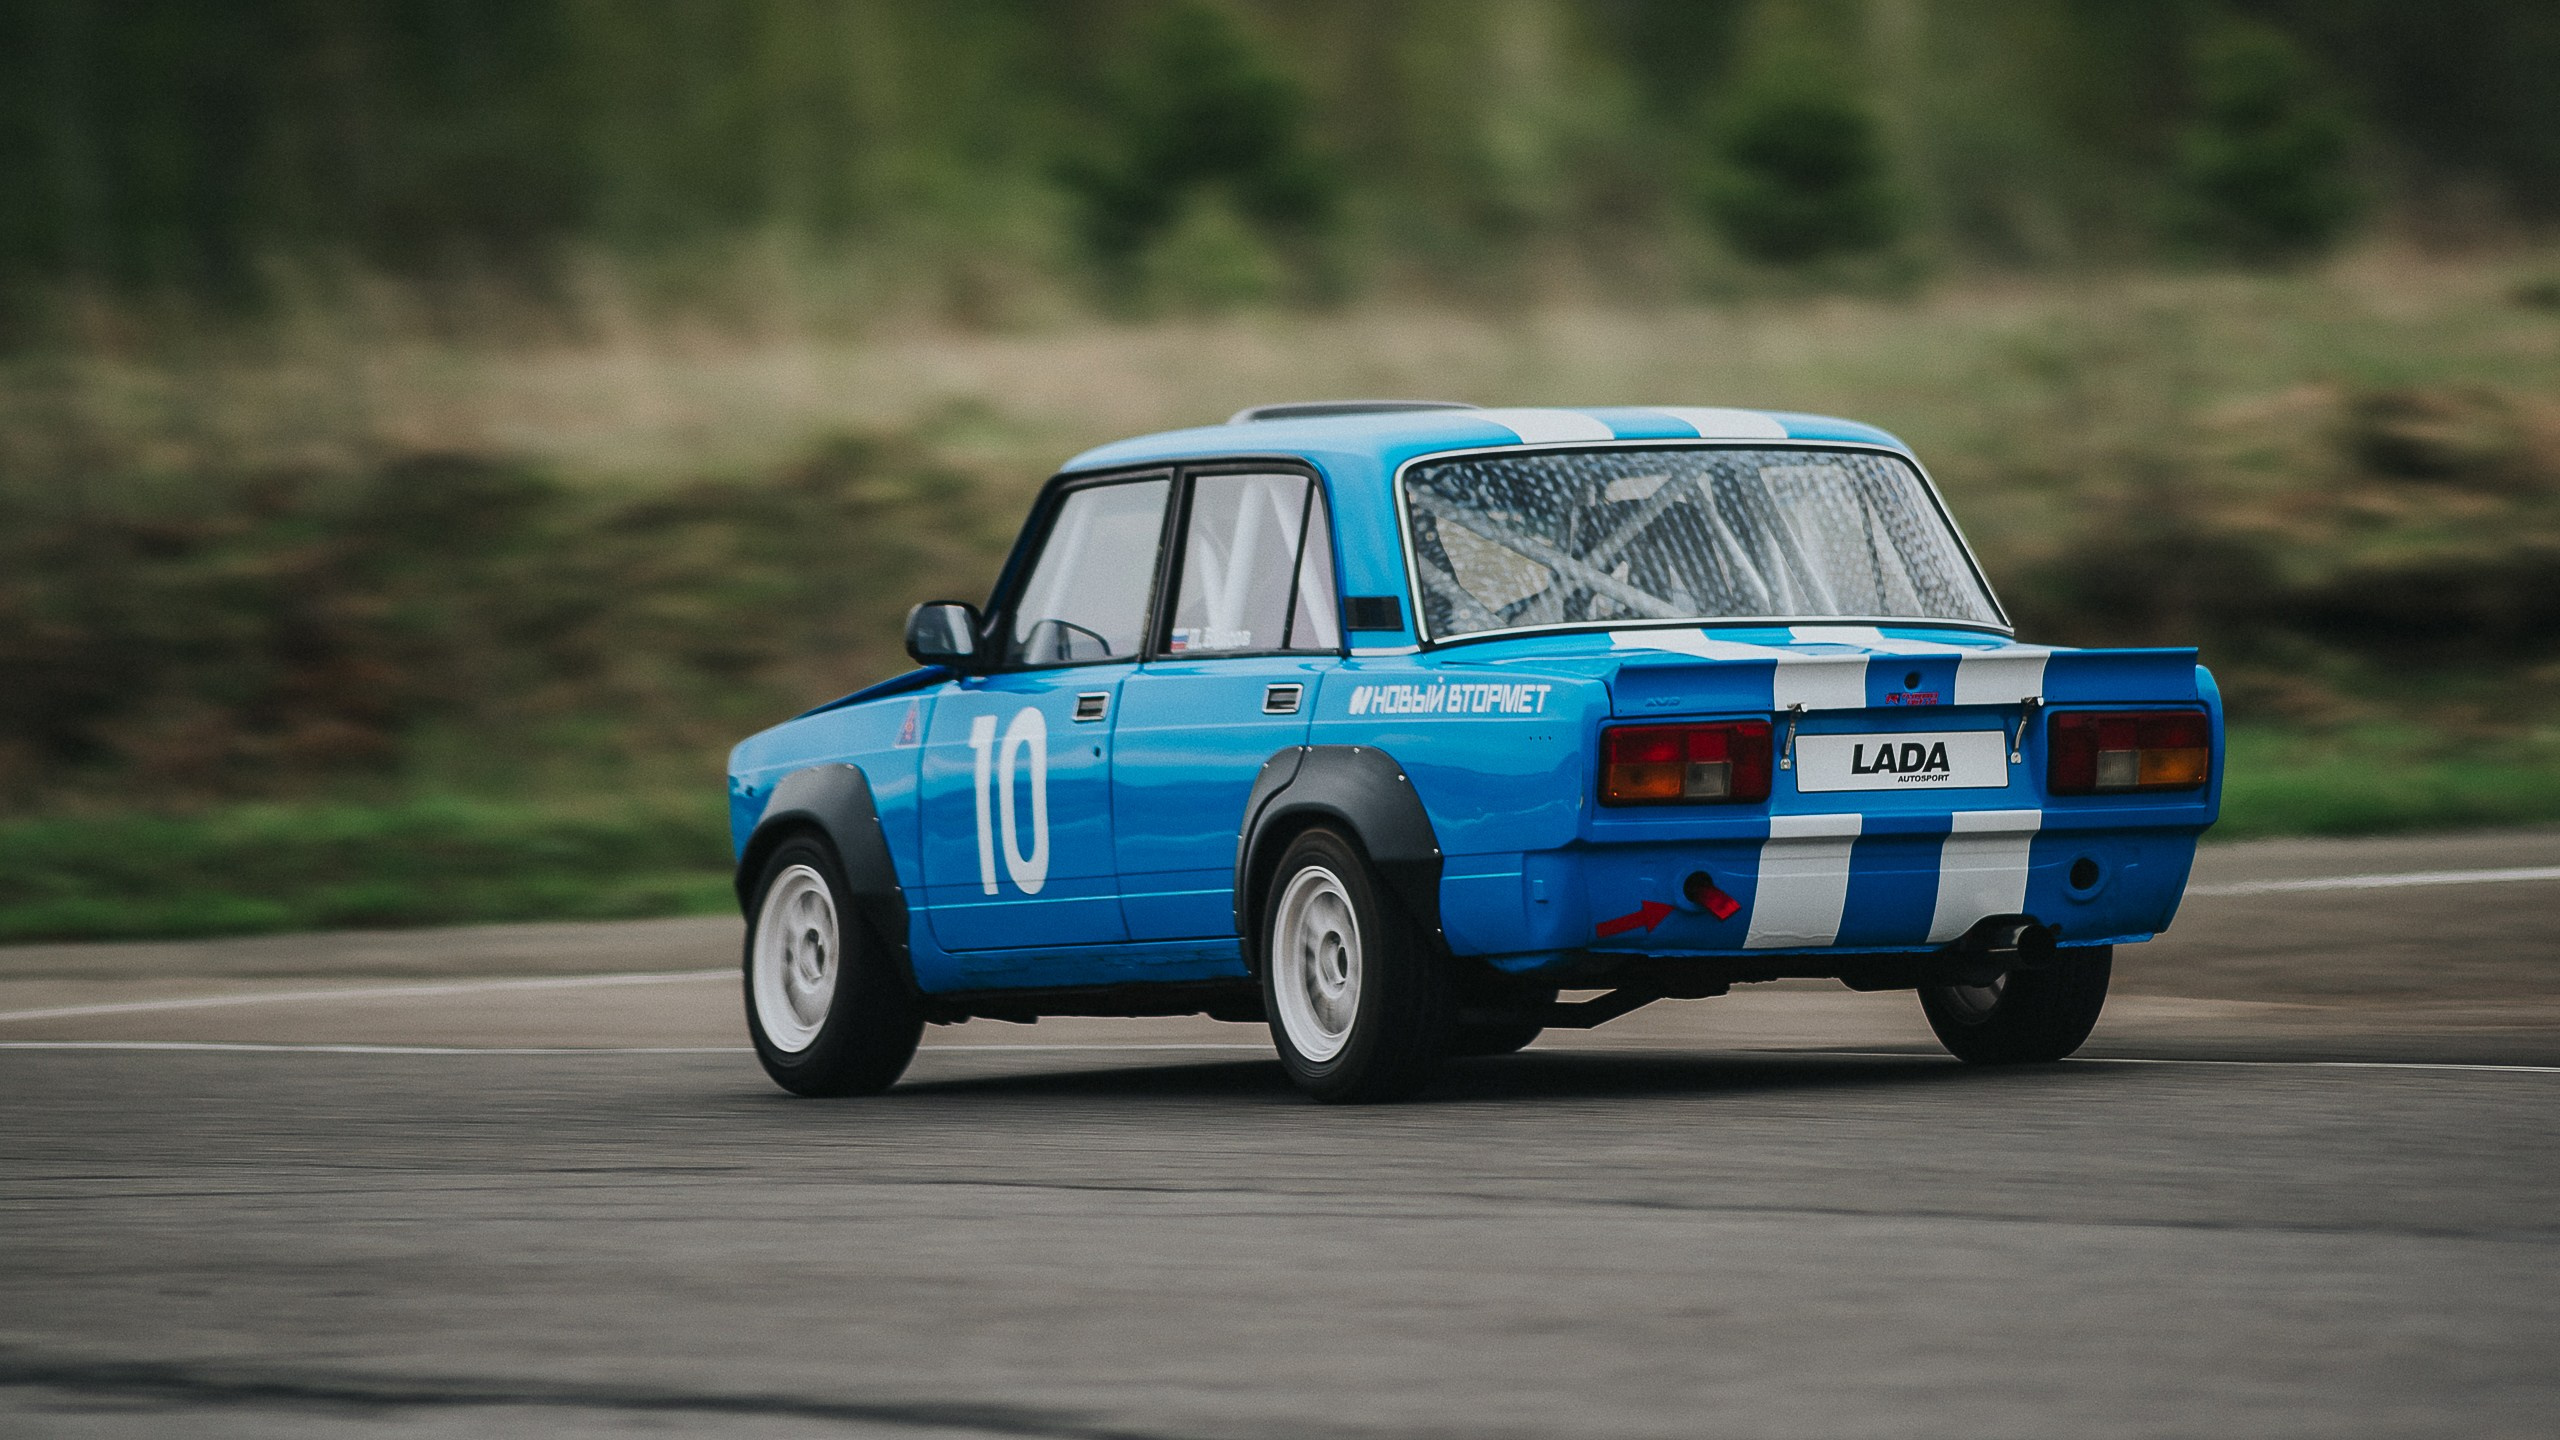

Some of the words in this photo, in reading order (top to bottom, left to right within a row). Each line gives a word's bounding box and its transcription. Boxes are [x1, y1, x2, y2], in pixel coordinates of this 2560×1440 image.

[1370, 676, 1445, 714] НОВЫЙ
[1446, 684, 1552, 713] ВТОРМЕТ
[1851, 741, 1951, 774] LADA
[1897, 774, 1950, 783] AUTOSPORT
[968, 706, 1049, 895] 10
